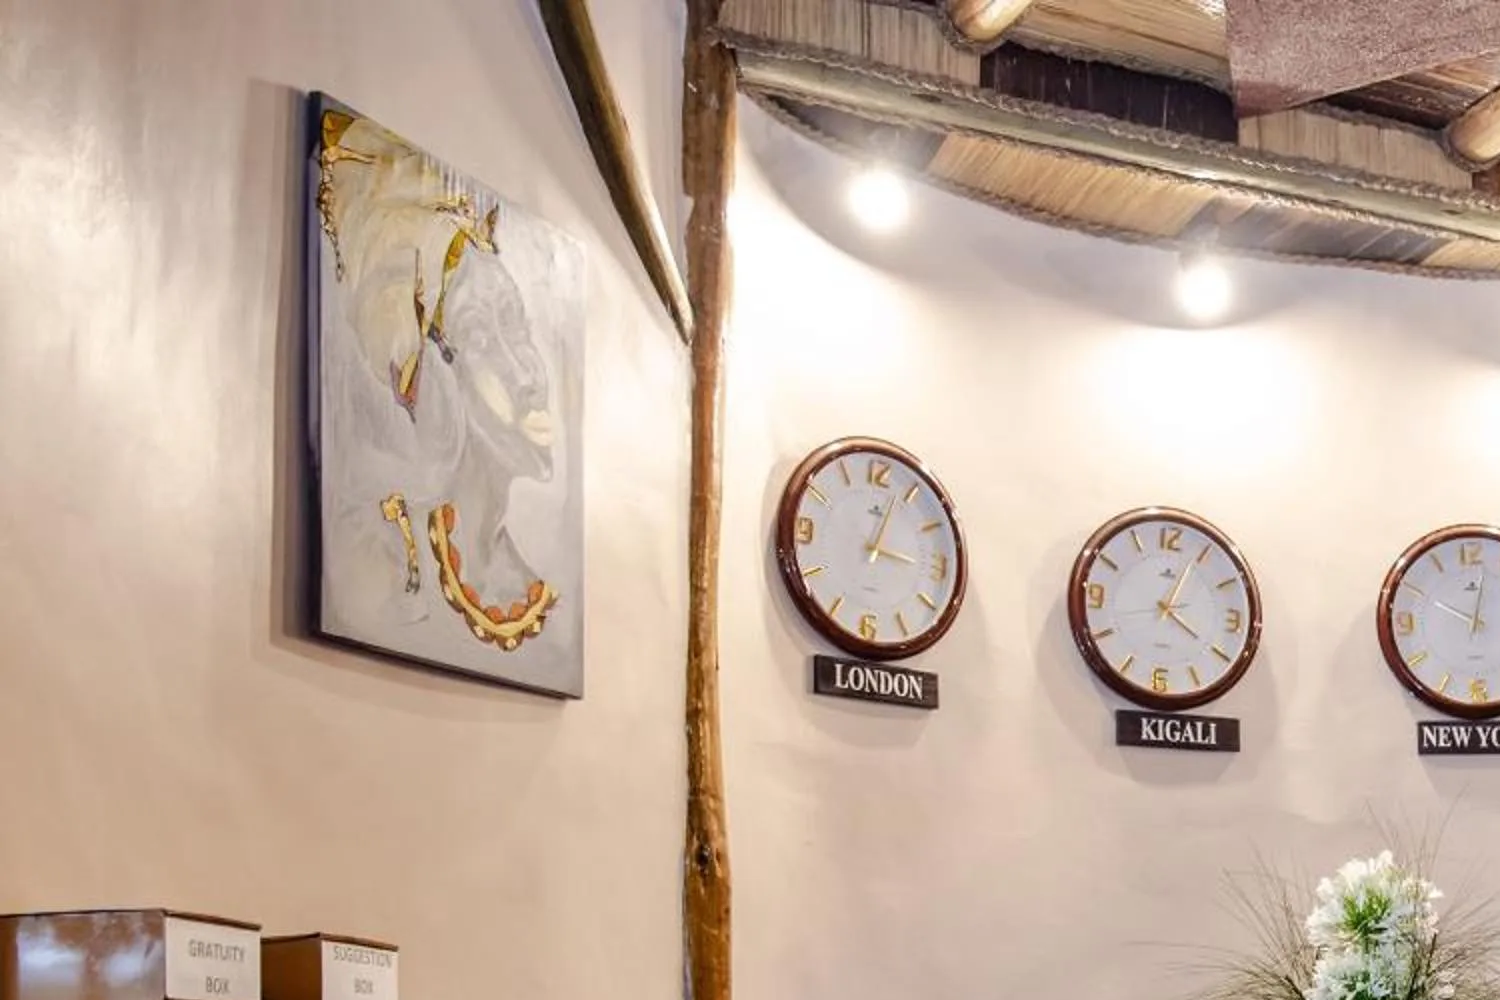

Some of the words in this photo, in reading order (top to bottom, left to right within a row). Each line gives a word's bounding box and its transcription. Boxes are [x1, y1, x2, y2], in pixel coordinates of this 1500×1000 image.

[868, 460, 890, 488] 12
[797, 517, 814, 544] 9
[1160, 527, 1183, 551] 12
[1459, 543, 1483, 565] 12
[932, 554, 948, 582] 3
[1088, 584, 1104, 608] 9
[860, 614, 877, 640] 6
[1226, 609, 1241, 634] 3
[1397, 612, 1414, 636] 9
[834, 663, 923, 700] LONDON
[1153, 668, 1168, 692] 6
[1468, 679, 1488, 703] 6
[1140, 717, 1217, 744] KIGALI
[1422, 726, 1473, 748] NEW
[188, 939, 247, 963] GRATUITY
[333, 945, 393, 969] SUGGESTION
[206, 976, 230, 995] BOX
[354, 979, 374, 995] BOX
